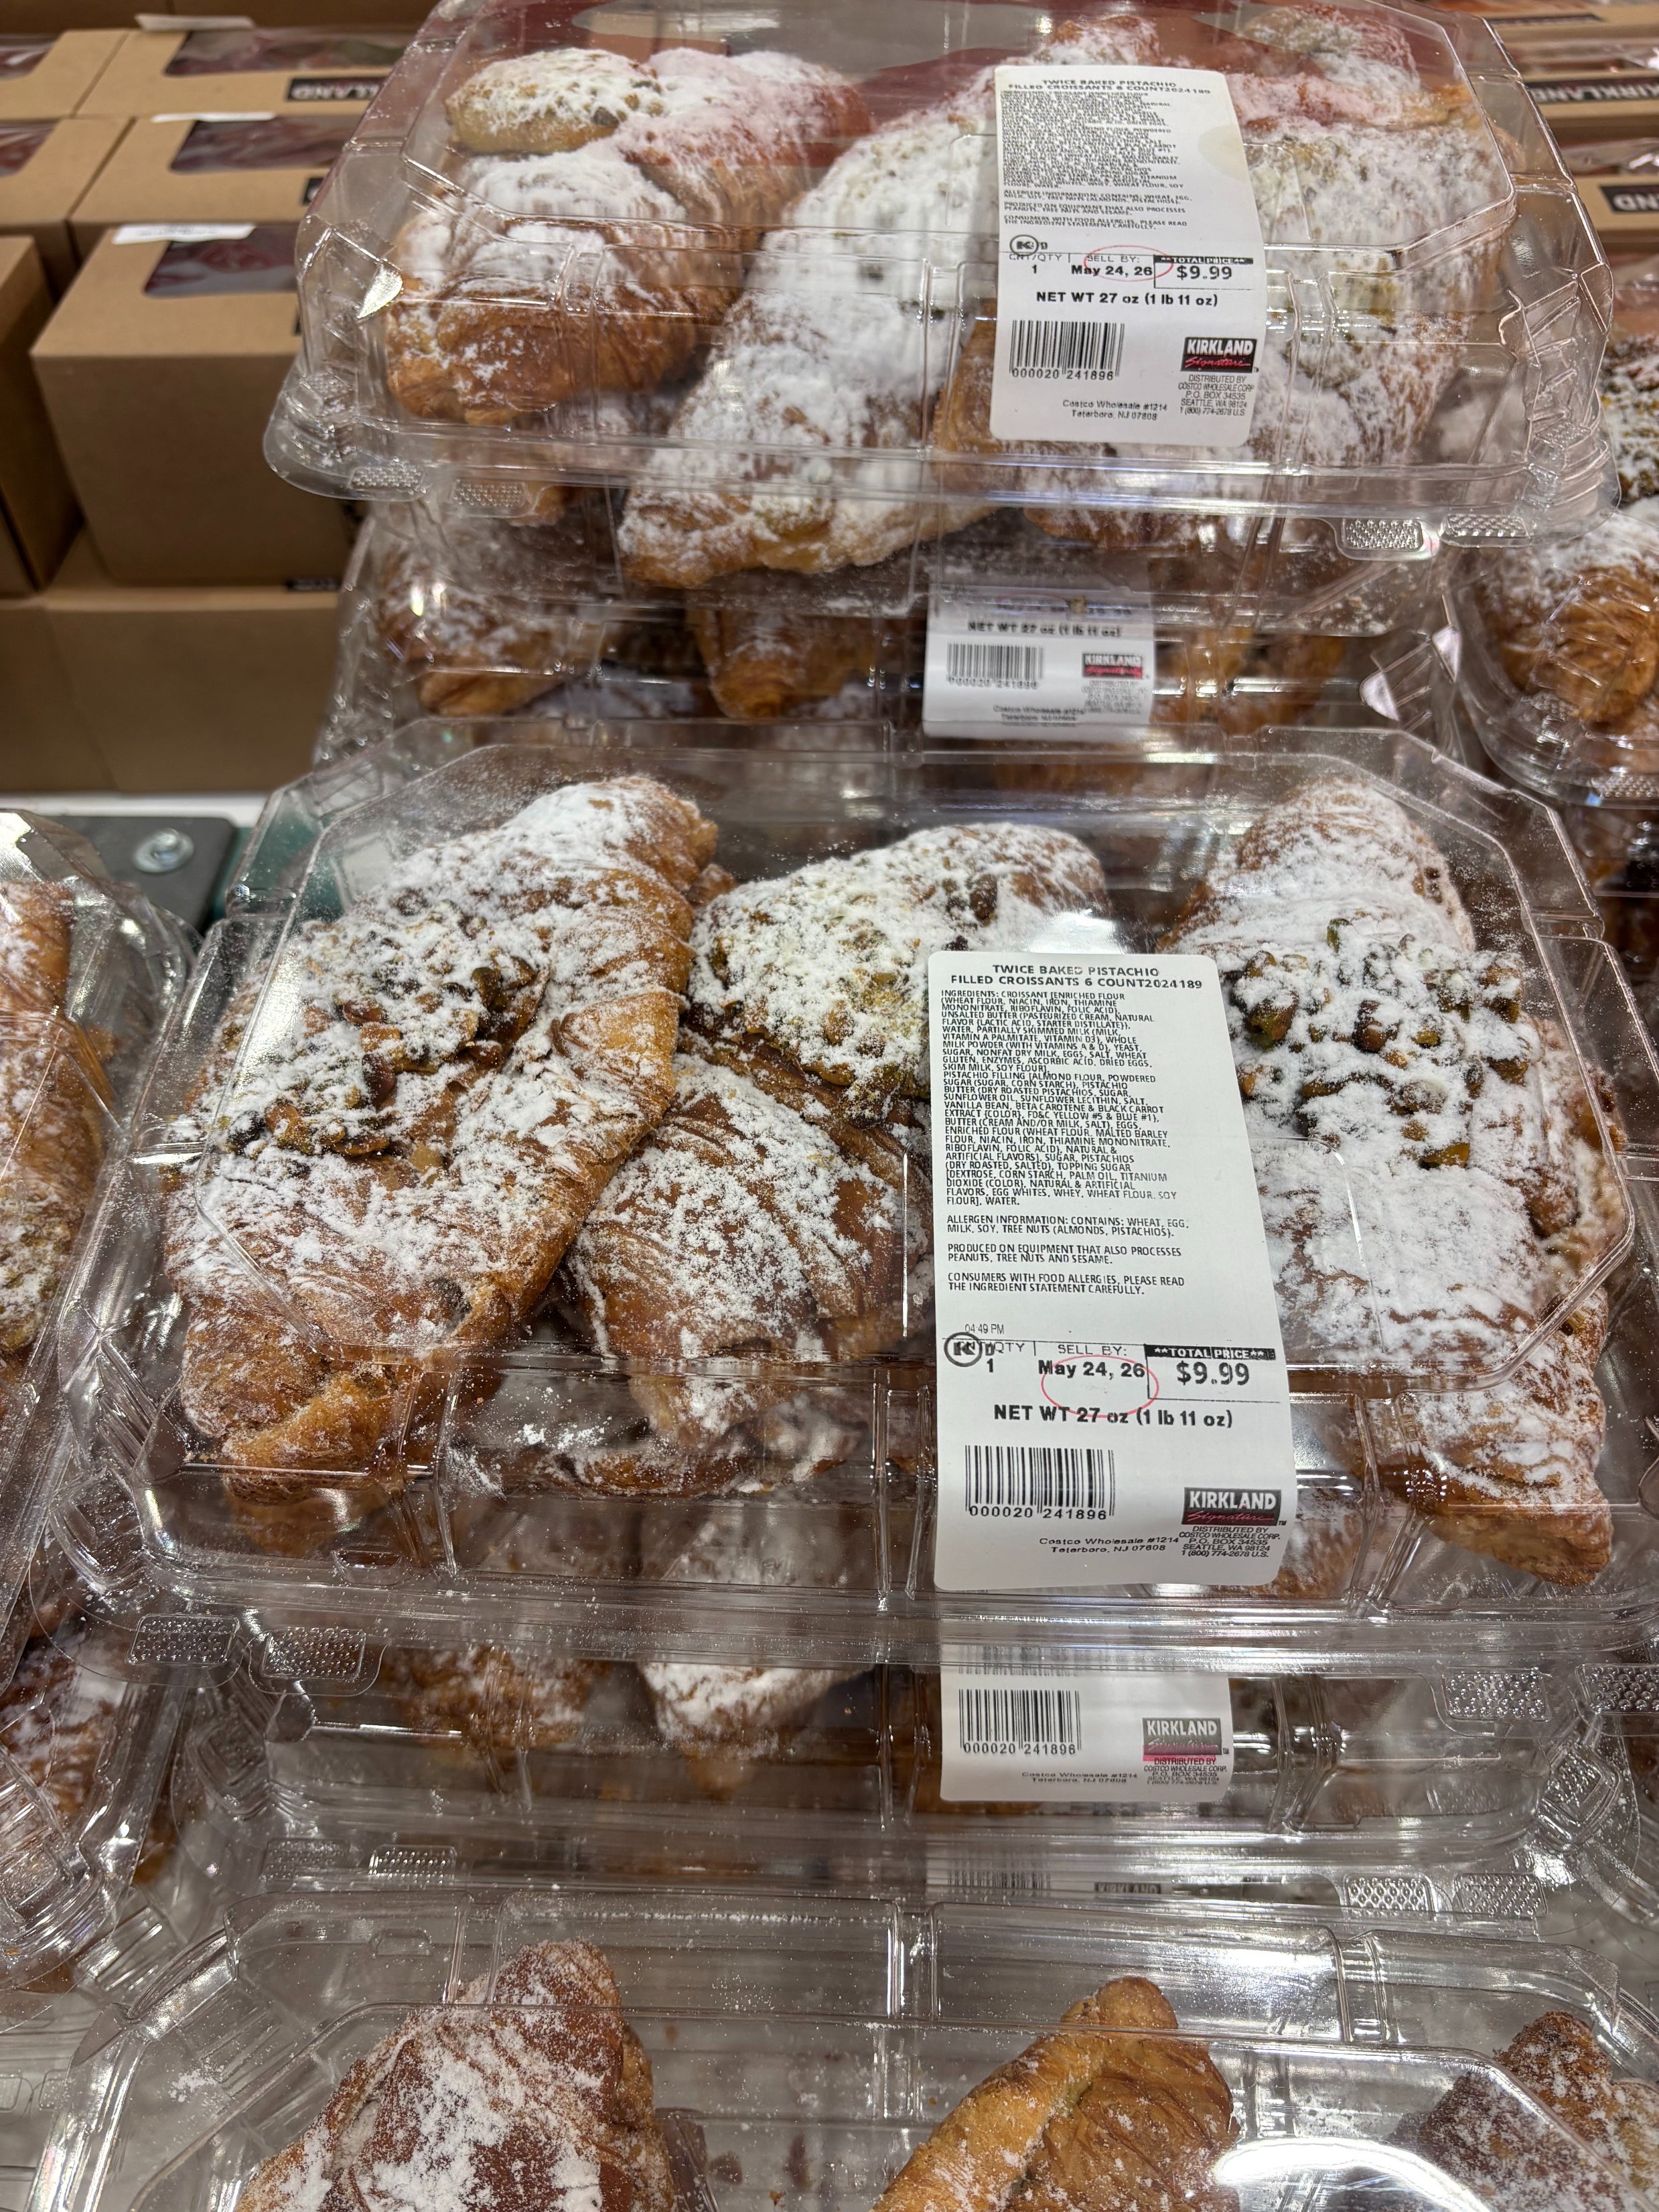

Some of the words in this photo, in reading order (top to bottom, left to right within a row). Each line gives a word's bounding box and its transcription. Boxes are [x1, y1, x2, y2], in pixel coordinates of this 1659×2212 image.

[1121, 255, 1139, 263] BY:
[1031, 264, 1037, 274] 1
[1072, 265, 1100, 277] May
[1106, 266, 1129, 277] 24,
[1134, 267, 1153, 276] 26
[1177, 265, 1232, 280] $9.99
[1037, 291, 1066, 302] NET
[1072, 292, 1094, 303] WT
[1099, 293, 1117, 303] 27
[1123, 295, 1139, 304] oz
[1145, 293, 1155, 305] (1
[1161, 294, 1173, 305] lb
[1178, 295, 1189, 305] 11
[1196, 294, 1218, 307] oz)
[1187, 339, 1253, 356] KIRKLAND
[1185, 356, 1250, 370] Signature
[1011, 368, 1059, 379] 000020
[1066, 370, 1113, 380] 241896
[1188, 374, 1234, 383] DISTRIBUTED
[1236, 375, 1247, 384] BY
[1204, 391, 1222, 399] BOX
[1063, 400, 1094, 408] Costco
[1096, 400, 1140, 409] Wholesale
[1084, 654, 1141, 666] KIRKLAND
[992, 964, 1034, 974] TWICE
[1039, 966, 1083, 975] BAKED
[1088, 966, 1159, 976] PISTACHIO
[951, 975, 993, 984] FILLED
[998, 976, 1080, 986] CROISSANTS
[1084, 978, 1093, 986] 6
[1097, 978, 1202, 988] COUNT2024189
[946, 1214, 993, 1224] ALLERGEN
[996, 1215, 1069, 1225] INFORMATION:
[1070, 1217, 1124, 1226] CONTAINS:
[1127, 1218, 1164, 1227] WHEAT,
[1165, 1219, 1189, 1228] EGG,
[947, 1224, 975, 1233] MILK,
[977, 1224, 999, 1233] SOY,
[1002, 1225, 1023, 1234] TREE
[1026, 1225, 1050, 1234] NUTS
[1052, 1226, 1108, 1236] (ALMONDS,
[1111, 1227, 1174, 1237] PISTACHIOS).
[948, 1243, 997, 1252] PRODUCED
[999, 1244, 1015, 1253] ON
[1017, 1244, 1074, 1254] EQUIPMENT
[1077, 1246, 1100, 1254] THAT
[1104, 1246, 1127, 1255] ALSO
[1131, 1246, 1181, 1256] PROCESSES
[948, 1252, 993, 1262] PEANUTS,
[995, 1253, 1017, 1262] TREE
[1020, 1254, 1045, 1263] NUTS
[1048, 1254, 1070, 1263] AND
[1071, 1254, 1112, 1264] SESAME.
[948, 1272, 1007, 1282] CONSUMERS
[1009, 1273, 1035, 1282] WITH
[1038, 1274, 1065, 1283] FOOD
[1068, 1274, 1121, 1284] ALLERGIES,
[1123, 1276, 1157, 1285] PLEASE
[1159, 1276, 1184, 1286] READ
[948, 1282, 966, 1291] THE
[968, 1282, 1027, 1292] INGREDIENT
[1029, 1283, 1086, 1293] STATEMENT
[1088, 1284, 1145, 1295] CAREFULLY.
[991, 1324, 1005, 1334] PM
[1058, 1344, 1093, 1355] SELL
[1102, 1345, 1127, 1355] BY:
[987, 1358, 993, 1373] 1
[1039, 1359, 1076, 1378] May
[1083, 1361, 1114, 1380] 24,
[1121, 1363, 1145, 1378] 26
[1176, 1359, 1250, 1386] $9.99
[994, 1404, 1033, 1420] NET
[1039, 1405, 1070, 1422] WT
[1076, 1407, 1100, 1422] 27
[1106, 1412, 1129, 1424] oz
[1137, 1406, 1150, 1426] (1
[1157, 1409, 1174, 1425] lb
[1179, 1410, 1196, 1426] 11
[1203, 1410, 1232, 1428] oz)
[1189, 1491, 1277, 1509] KIRKLAND
[970, 1505, 1033, 1518] 000020
[1043, 1508, 1106, 1520] 241896
[1187, 1510, 1275, 1524] Signature
[1192, 1526, 1254, 1534] DISTRIBUTED
[1147, 1720, 1218, 1736] KIRKLAND
[964, 1743, 1015, 1754] 000020
[1024, 1743, 1076, 1755] 241896
[1206, 1757, 1216, 1765] BY
